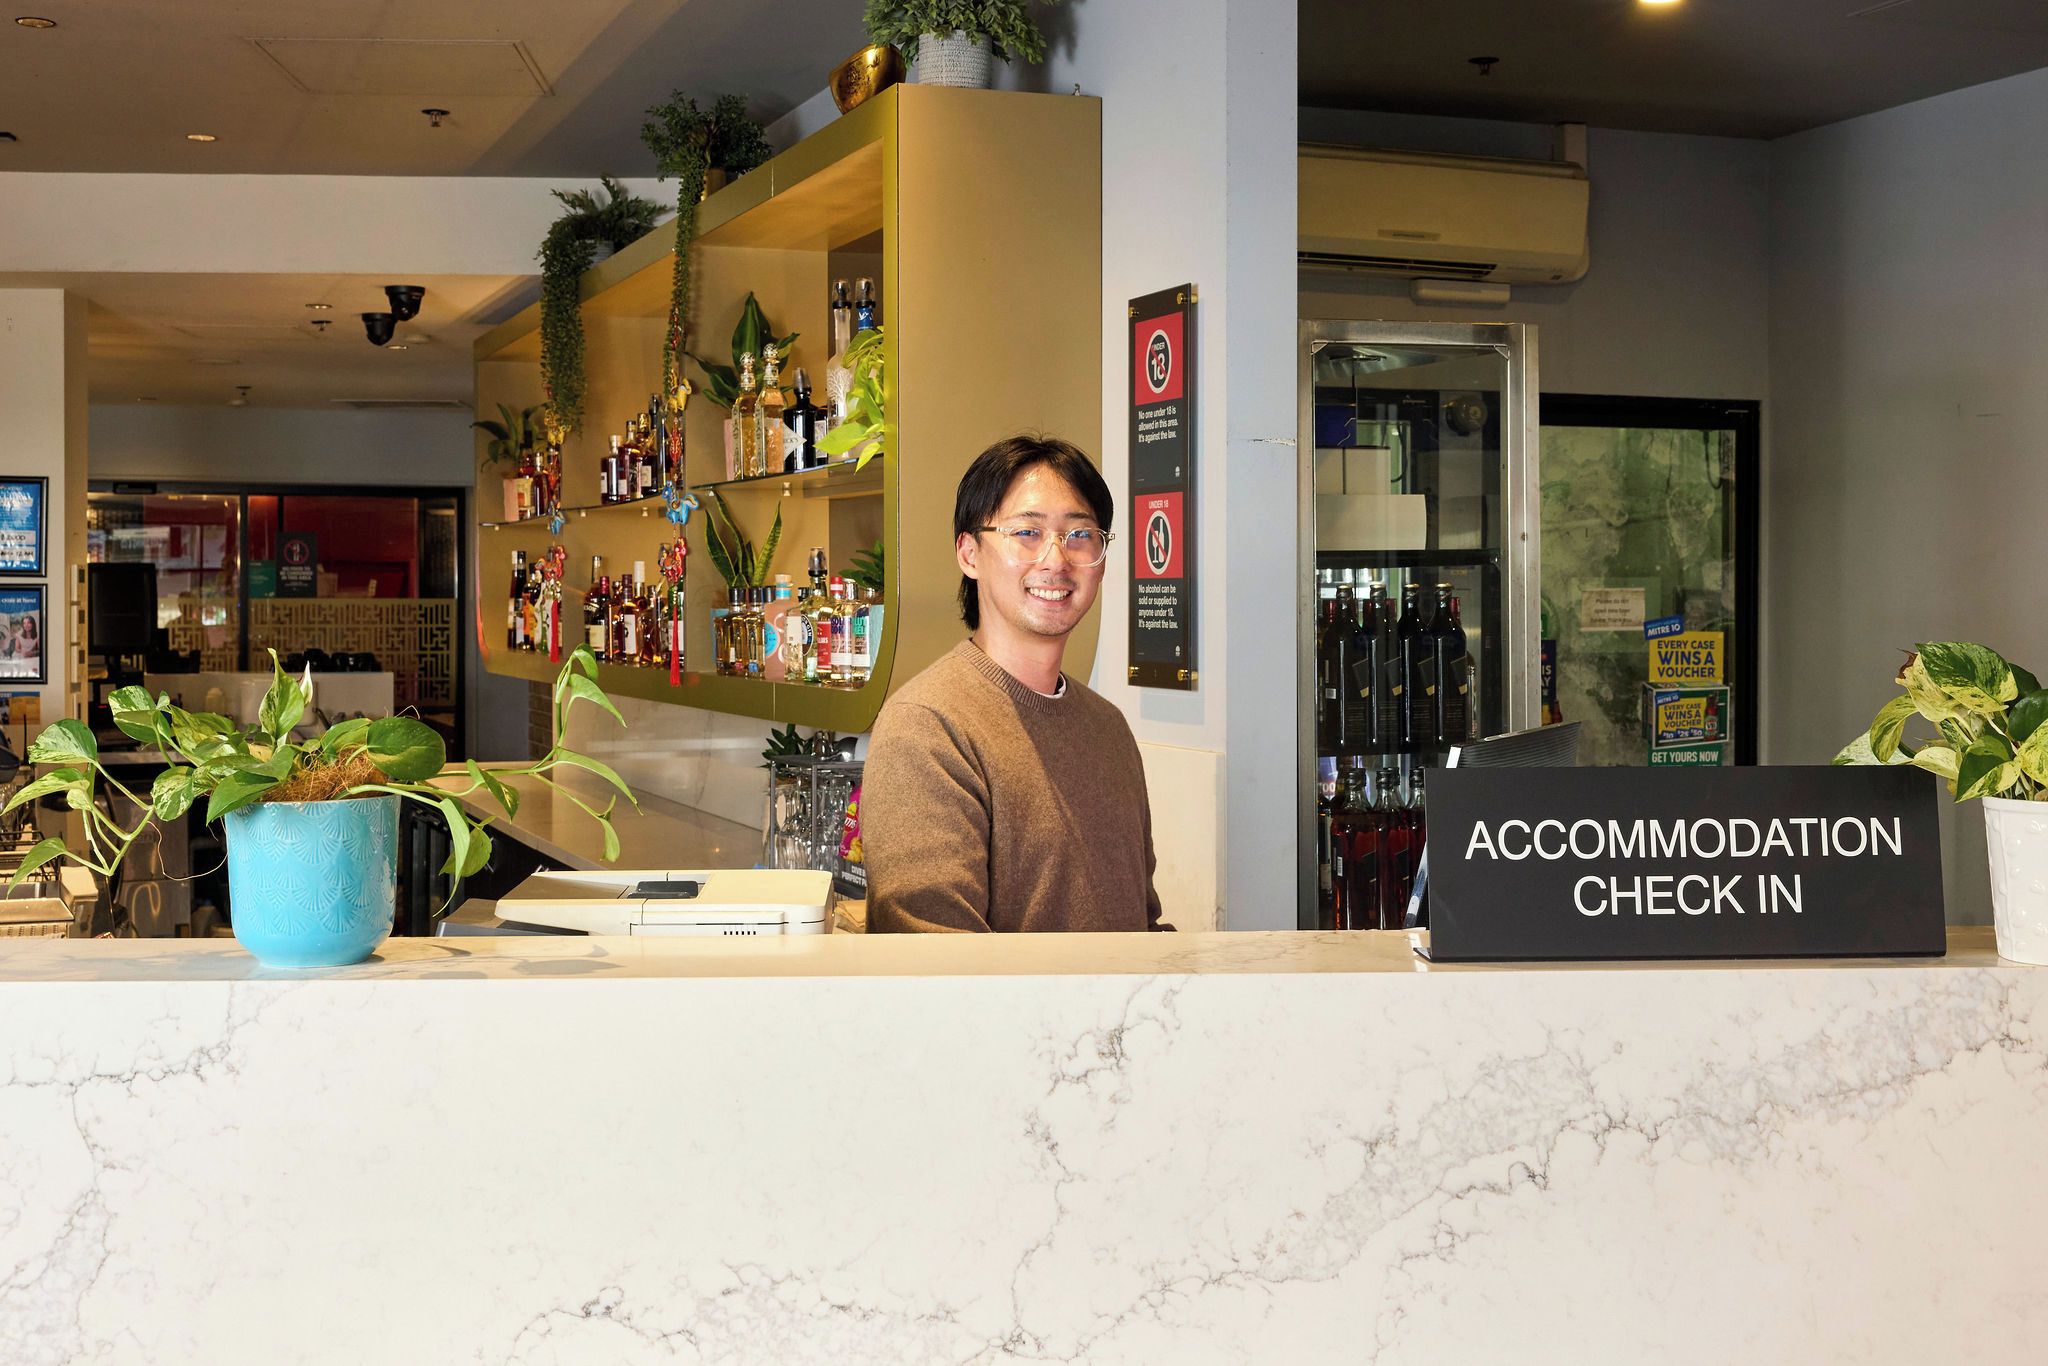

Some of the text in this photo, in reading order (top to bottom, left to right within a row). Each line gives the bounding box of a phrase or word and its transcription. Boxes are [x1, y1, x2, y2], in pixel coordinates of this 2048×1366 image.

[1151, 353, 1165, 380] 18
[1154, 408, 1166, 418] under
[1139, 420, 1154, 431] allowed
[1145, 431, 1160, 443] against
[1149, 500, 1163, 509] UNDER
[1139, 584, 1145, 593] No
[1146, 584, 1161, 593] alcohol
[1170, 584, 1176, 593] be
[1139, 596, 1148, 604] sold
[1154, 596, 1171, 606] supplied
[1139, 609, 1154, 618] anyone
[1155, 608, 1167, 616] under
[1146, 619, 1161, 630] against
[1648, 624, 1680, 636] MITRE 10
[1657, 641, 1715, 649] EVERY CASE
[1658, 651, 1715, 665] WINS A
[1657, 667, 1716, 677] VOUCHER
[1665, 710, 1701, 720] WINS A
[1664, 719, 1702, 728] VOUCHER
[1651, 751, 1719, 763] GET YOURS NOW
[1465, 817, 1902, 860] ACCOMMODATION
[1574, 874, 1802, 916] CHECK IN
